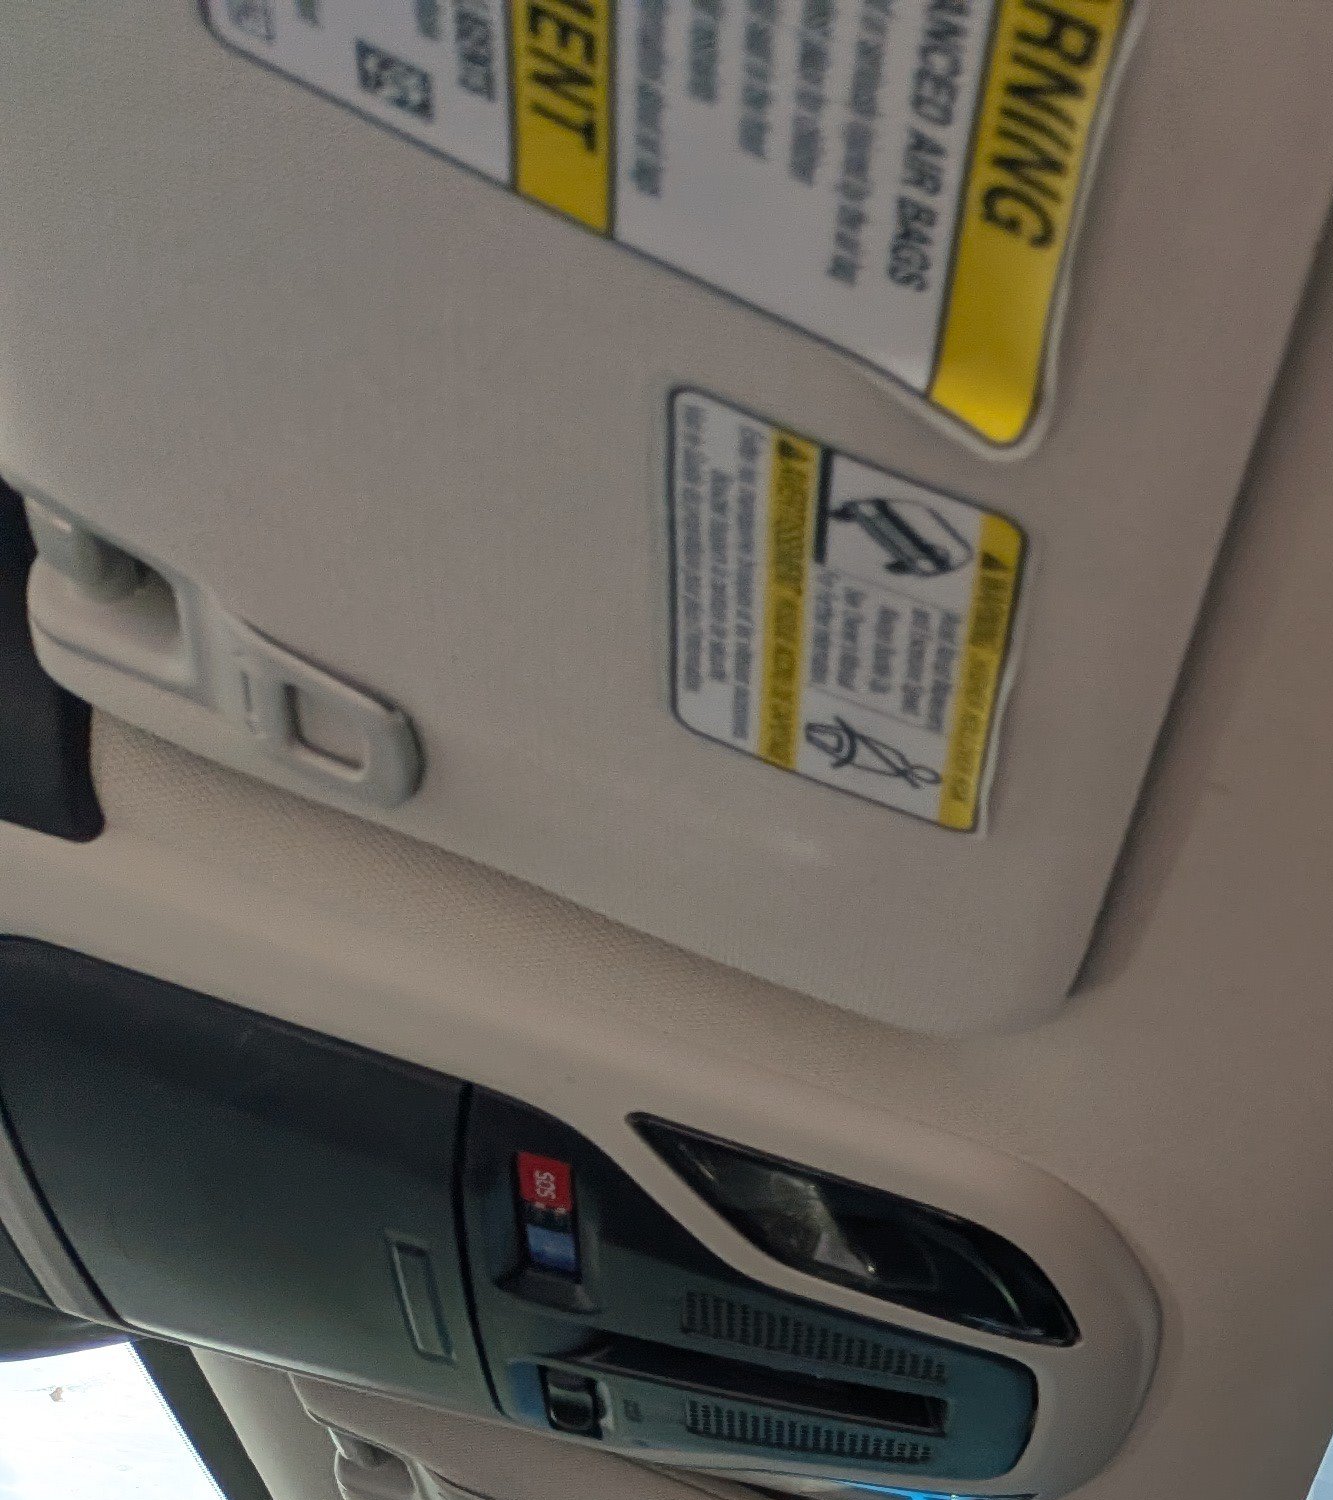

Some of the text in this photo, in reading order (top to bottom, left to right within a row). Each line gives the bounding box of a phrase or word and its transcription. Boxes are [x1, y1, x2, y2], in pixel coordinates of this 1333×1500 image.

[902, 128, 948, 196] AIR
[981, 0, 1105, 248] RNING
[888, 196, 939, 292] BAGS
[533, 1169, 557, 1200] SOS
